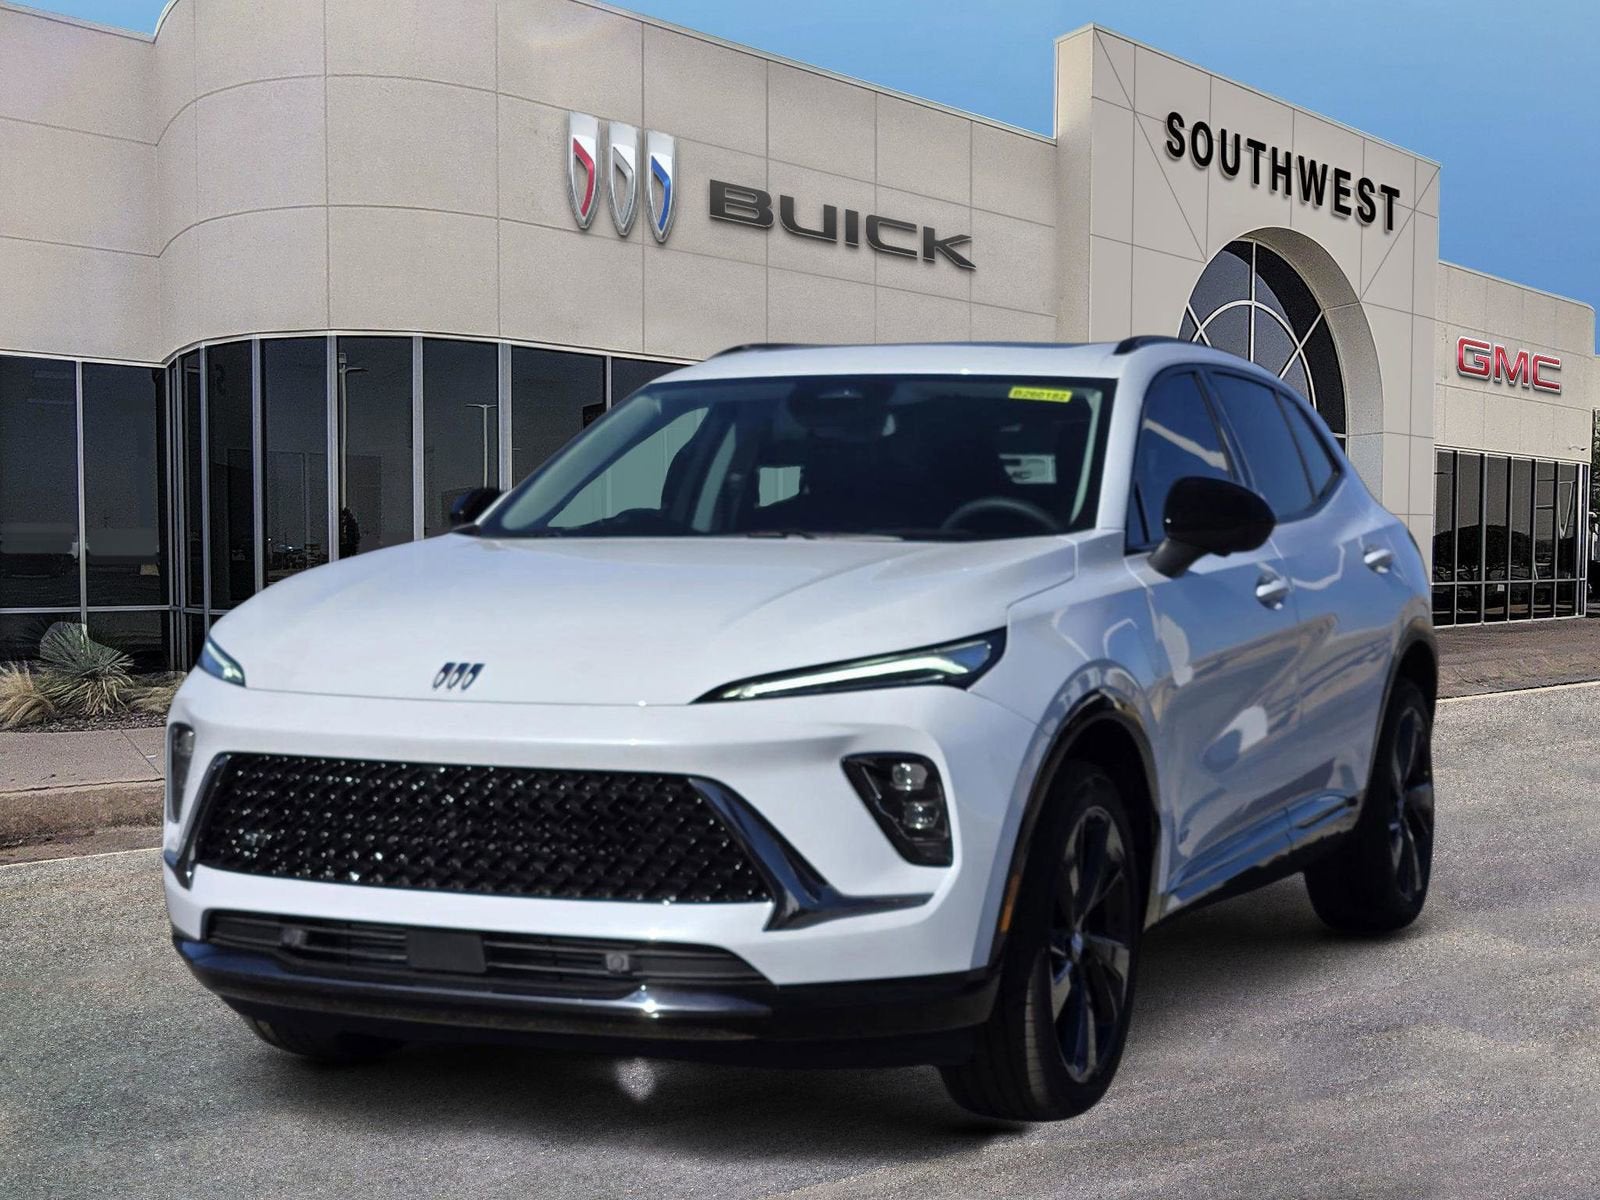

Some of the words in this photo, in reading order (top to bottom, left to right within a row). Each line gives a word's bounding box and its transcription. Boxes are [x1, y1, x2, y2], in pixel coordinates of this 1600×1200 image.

[1166, 111, 1400, 231] SOUTHWEST
[709, 179, 977, 270] BUICK
[1456, 335, 1562, 393] GMC
